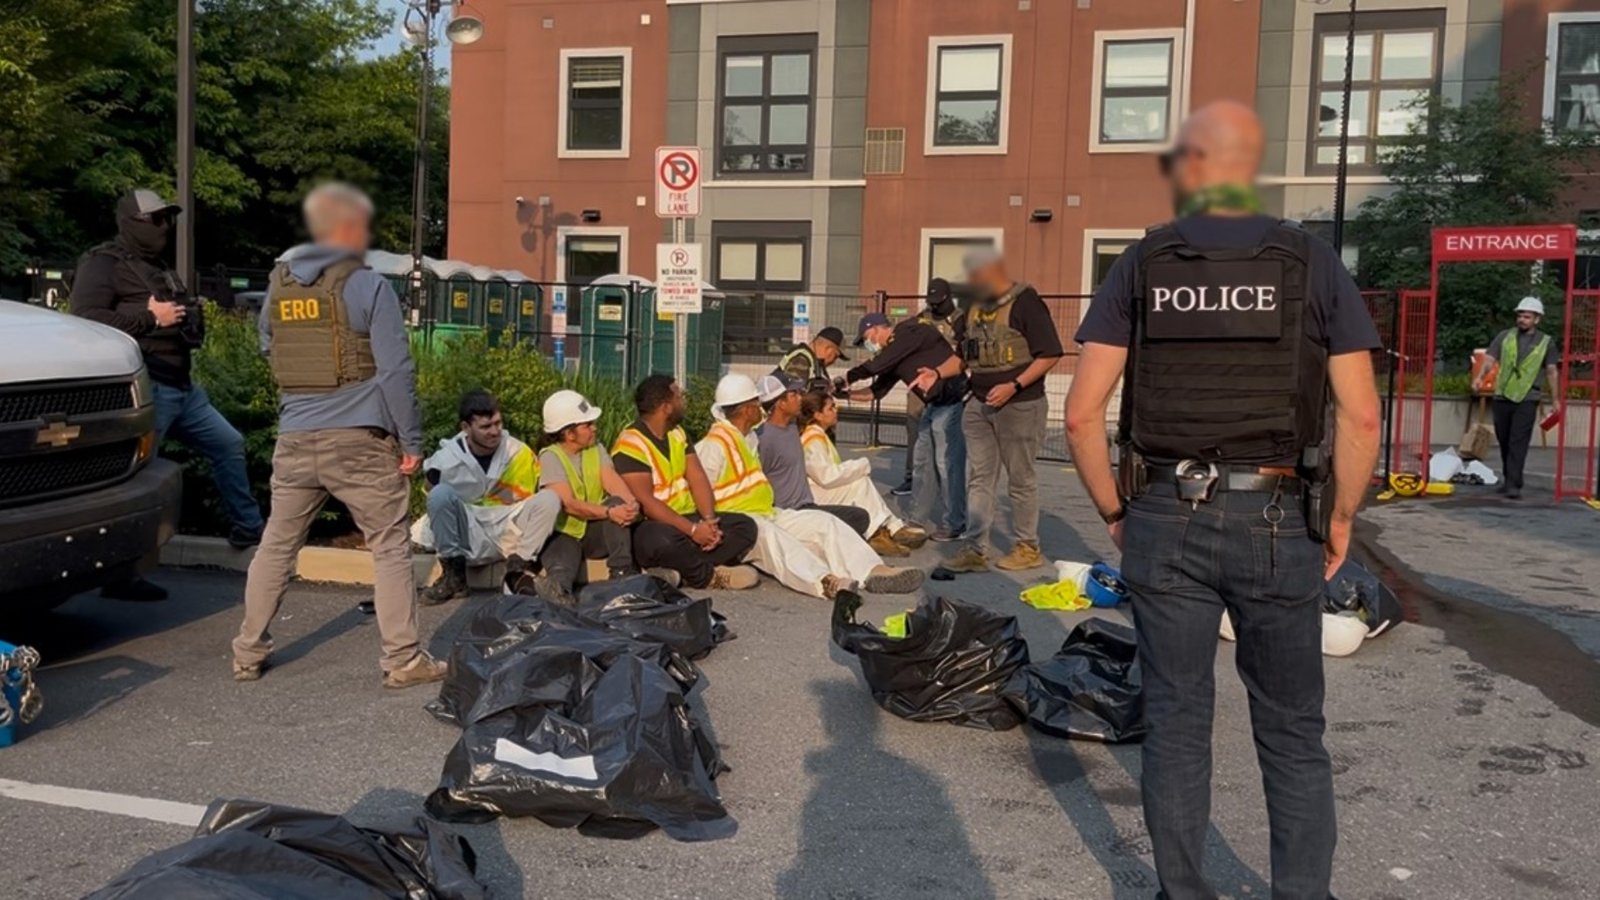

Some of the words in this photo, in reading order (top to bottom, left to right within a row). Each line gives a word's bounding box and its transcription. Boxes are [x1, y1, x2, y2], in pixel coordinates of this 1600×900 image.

[669, 193, 688, 203] FIRE
[668, 204, 689, 214] LANE
[1446, 234, 1559, 251] ENTRANCE
[661, 268, 671, 276] NO
[672, 268, 697, 276] PARKING
[1152, 286, 1278, 312] POLICE
[279, 299, 320, 321] ERO
